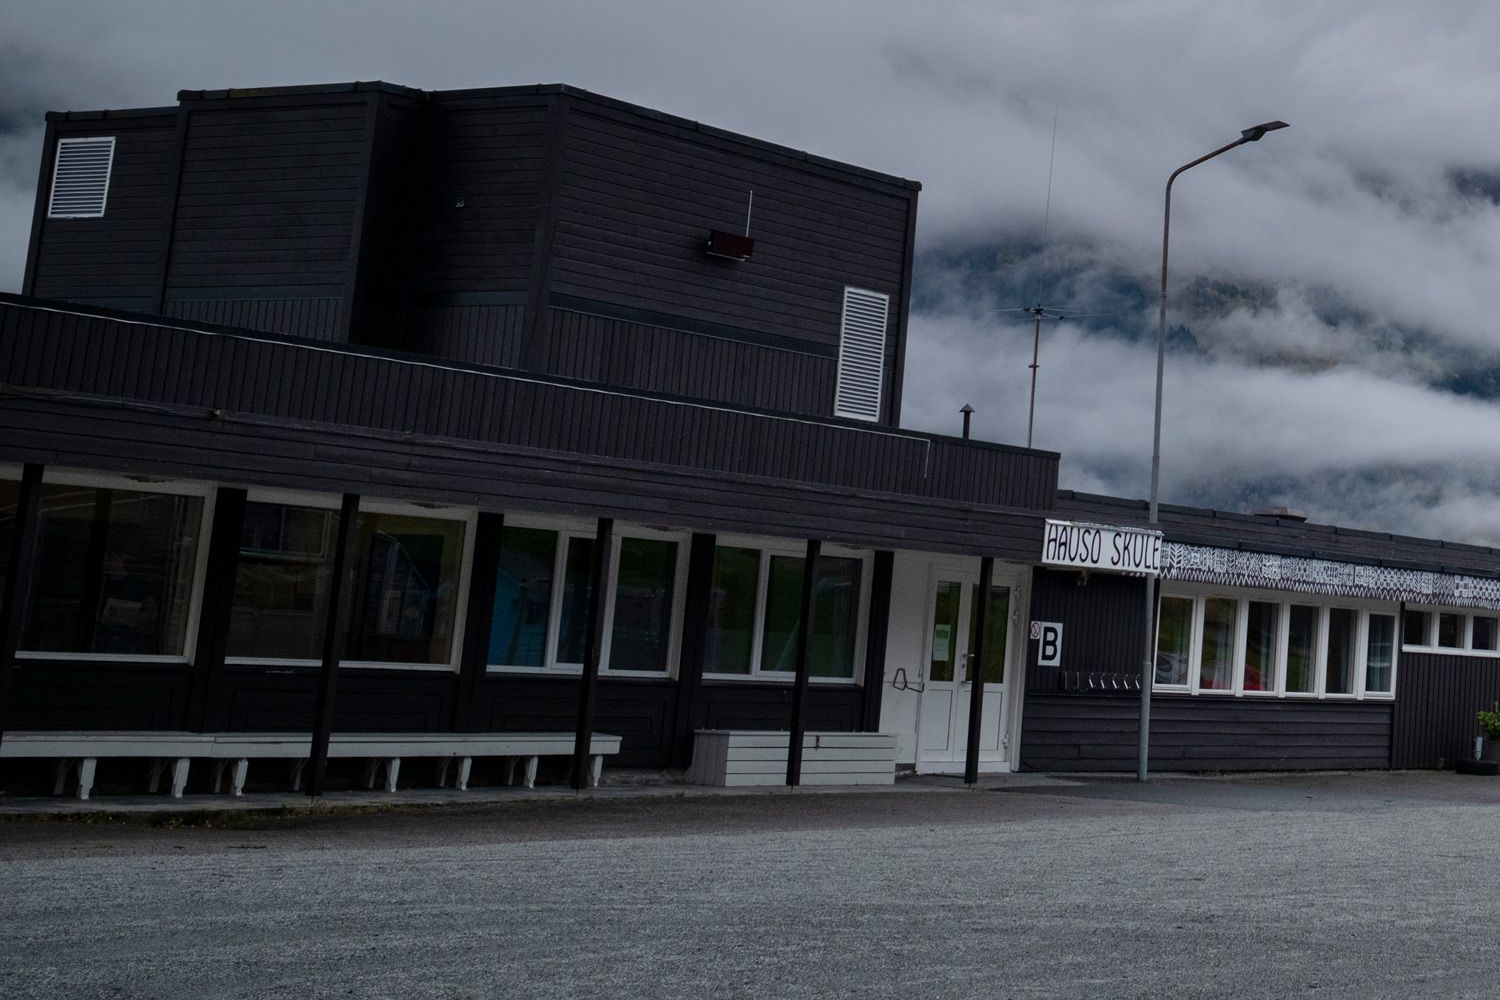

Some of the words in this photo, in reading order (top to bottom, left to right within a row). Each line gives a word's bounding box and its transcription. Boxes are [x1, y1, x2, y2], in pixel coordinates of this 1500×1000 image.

[1046, 524, 1101, 563] HAUSO
[1111, 532, 1160, 570] SKULE
[1041, 626, 1058, 661] B
